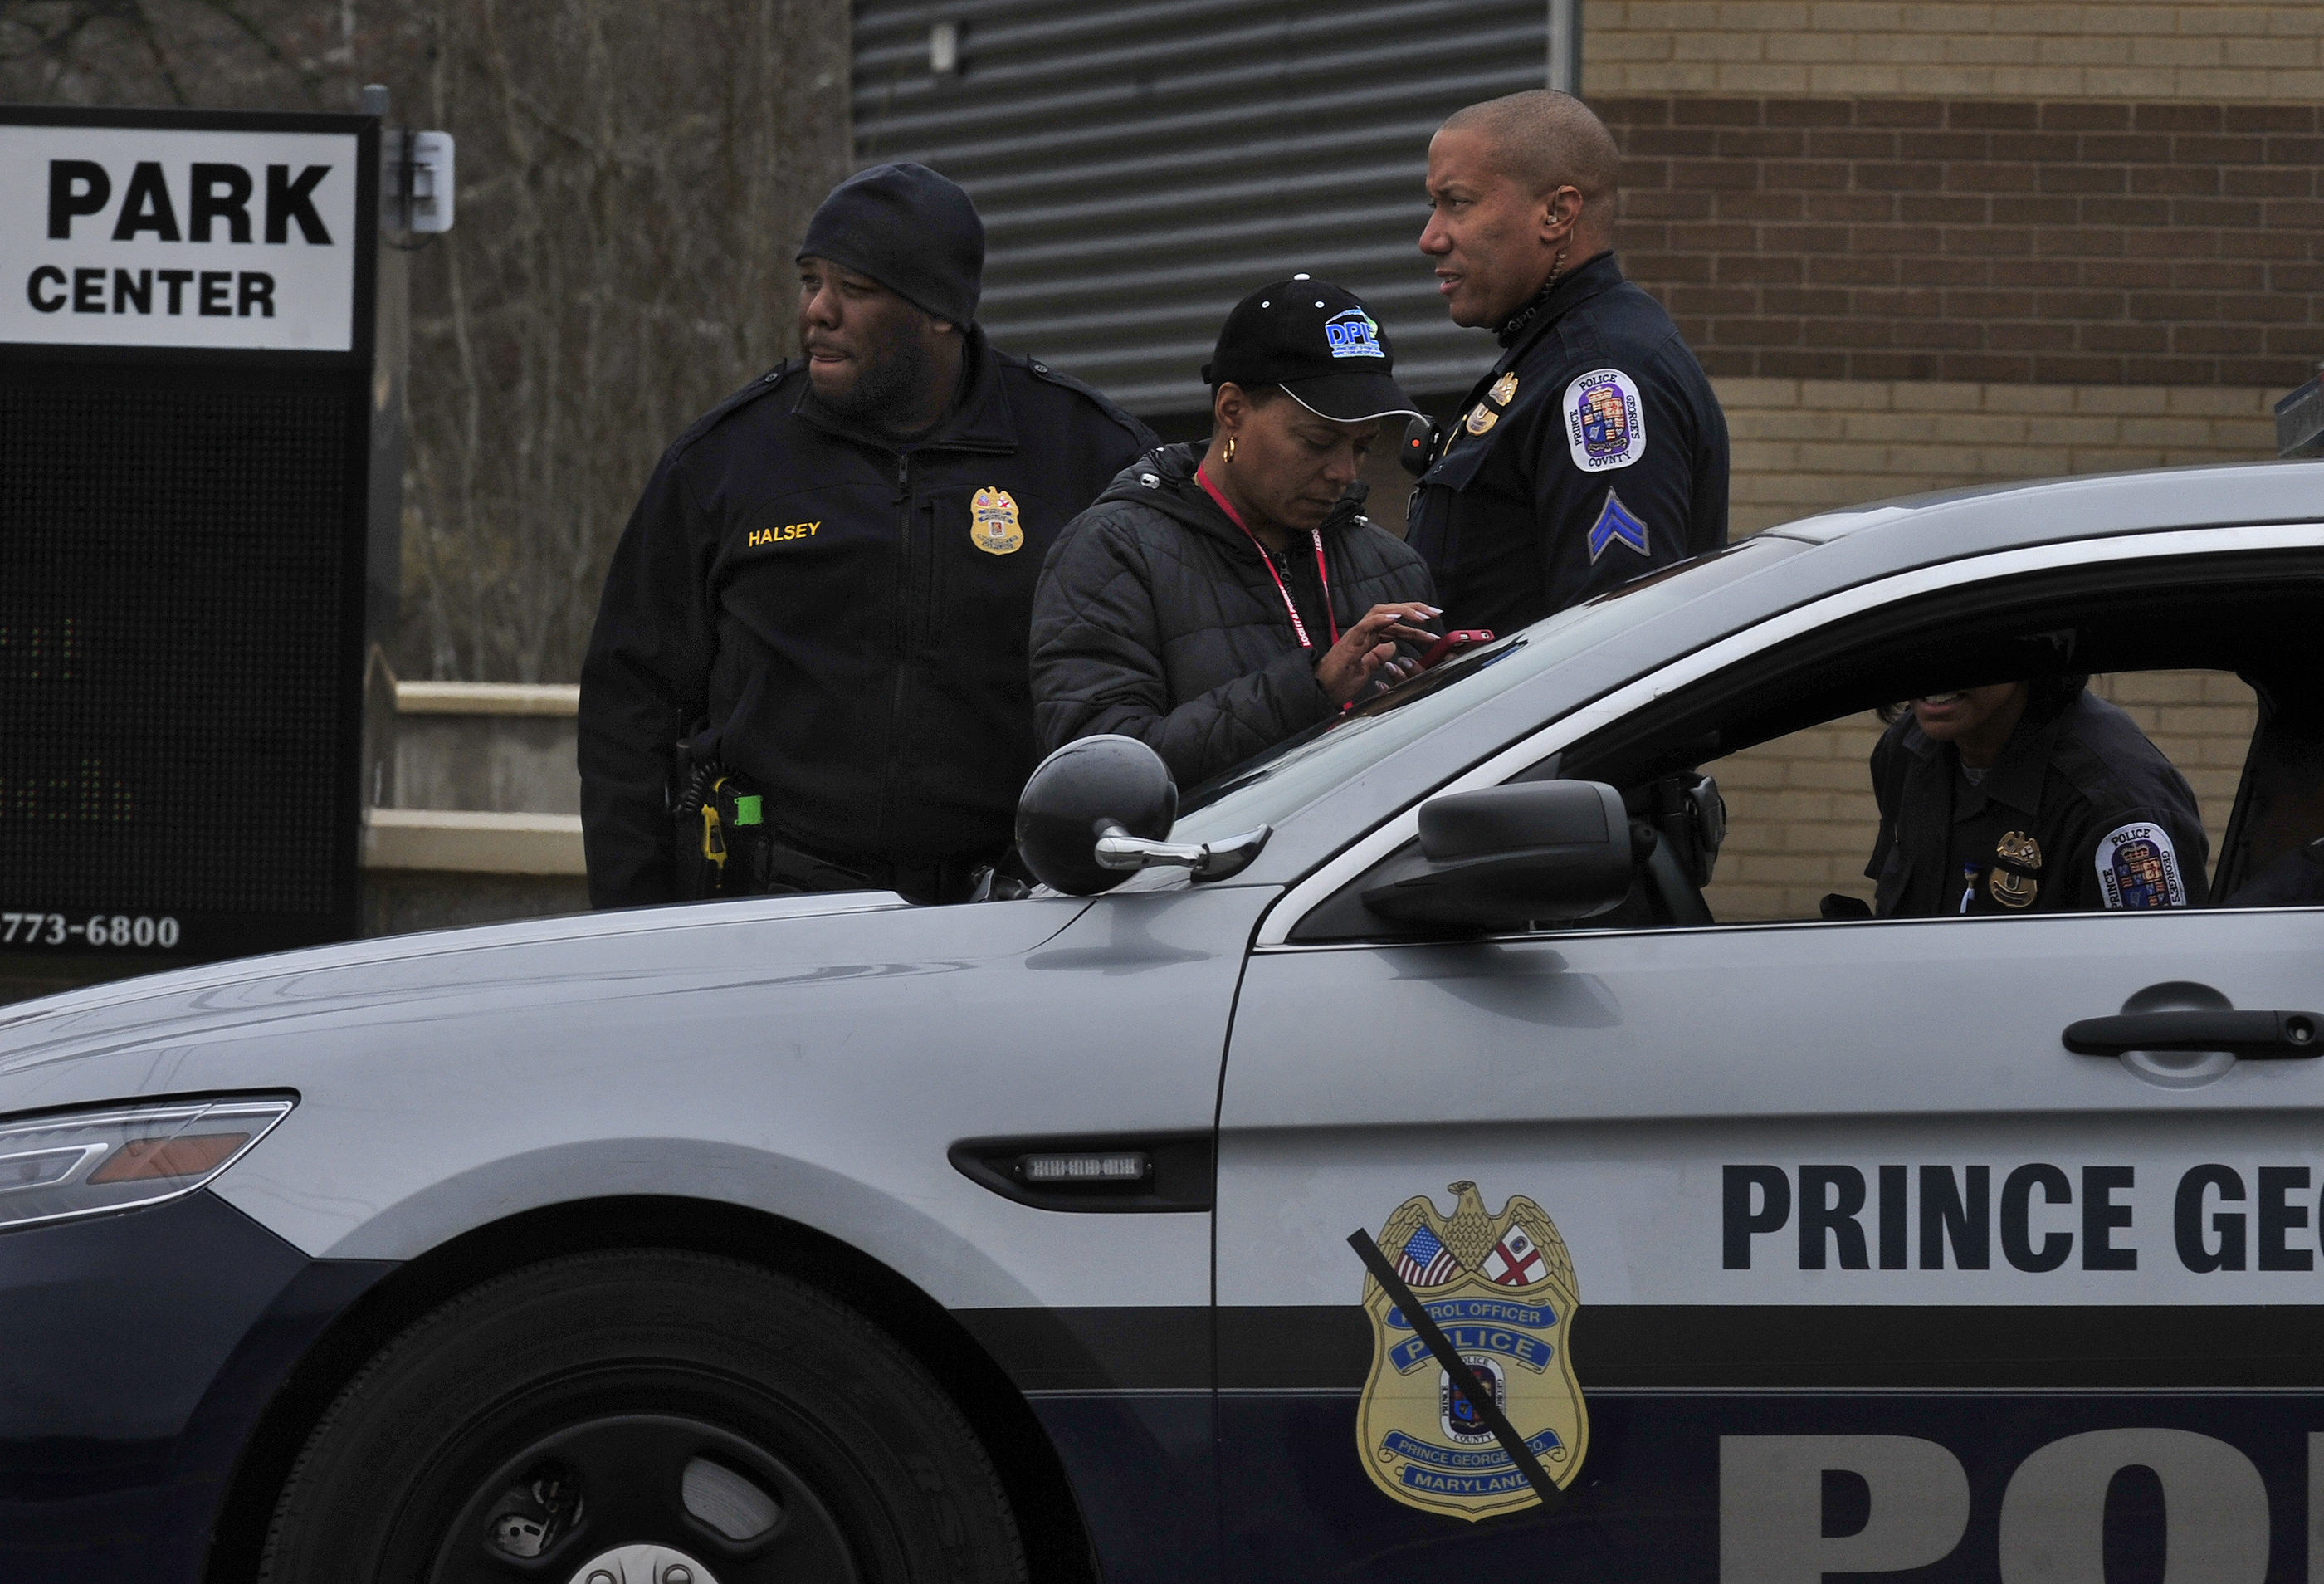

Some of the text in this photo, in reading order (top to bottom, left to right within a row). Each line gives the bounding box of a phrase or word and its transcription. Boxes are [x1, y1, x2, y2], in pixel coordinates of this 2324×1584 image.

[47, 159, 334, 246] PARK
[27, 265, 276, 318] CENTER
[1579, 374, 1618, 391] POLICE
[1570, 409, 1583, 446] PRINCE
[749, 521, 822, 547] HALSEY
[2111, 828, 2151, 847] POLICE
[2, 913, 180, 948] 773-6800
[1722, 1163, 2324, 1274] PRINCE GE
[1402, 1303, 1540, 1324] ROL OFFICER
[1462, 1357, 1490, 1366] OLICE
[1399, 1440, 1448, 1464] PRINCE
[1452, 1451, 1511, 1466] GEORGE
[1719, 1427, 2324, 1584] PO
